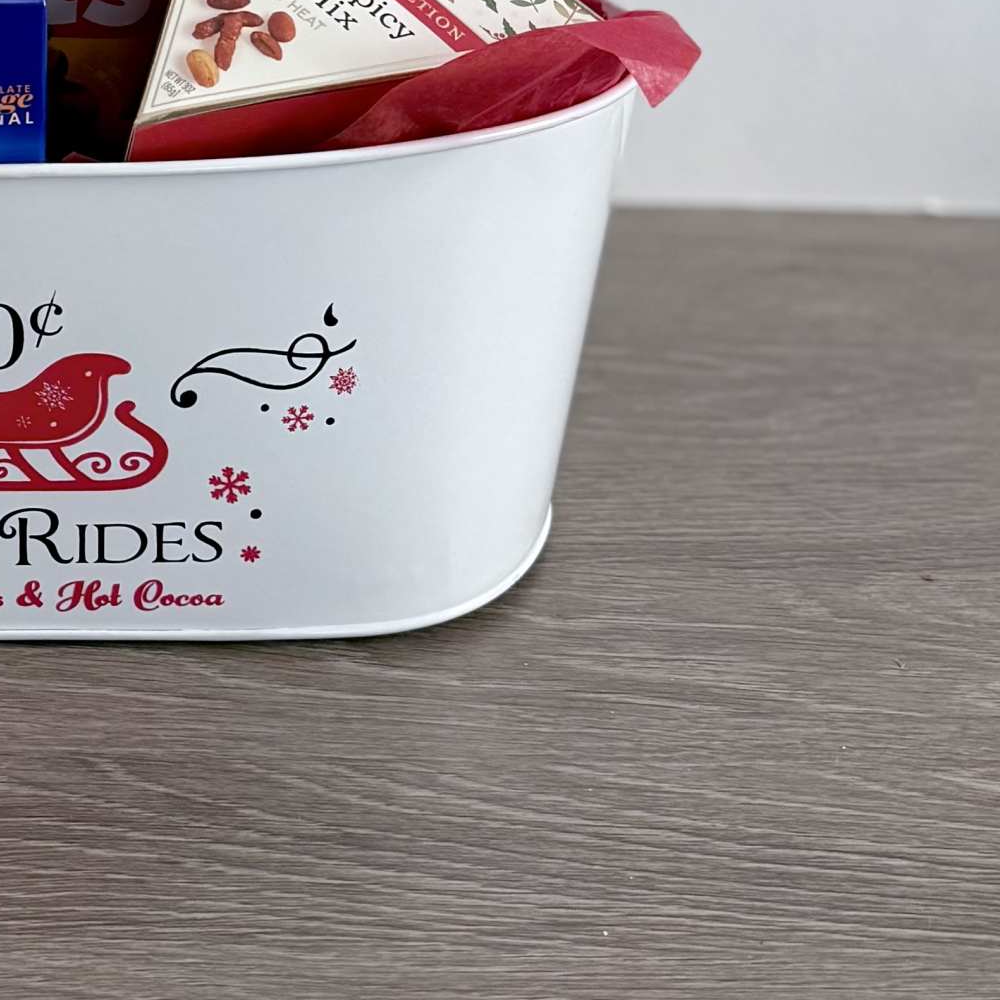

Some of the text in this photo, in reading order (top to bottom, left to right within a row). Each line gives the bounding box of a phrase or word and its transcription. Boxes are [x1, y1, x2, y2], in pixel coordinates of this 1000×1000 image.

[287, 1, 328, 31] HEAT
[16, 580, 45, 611] &
[56, 578, 122, 613] Hot
[132, 578, 225, 612] Cocoa
